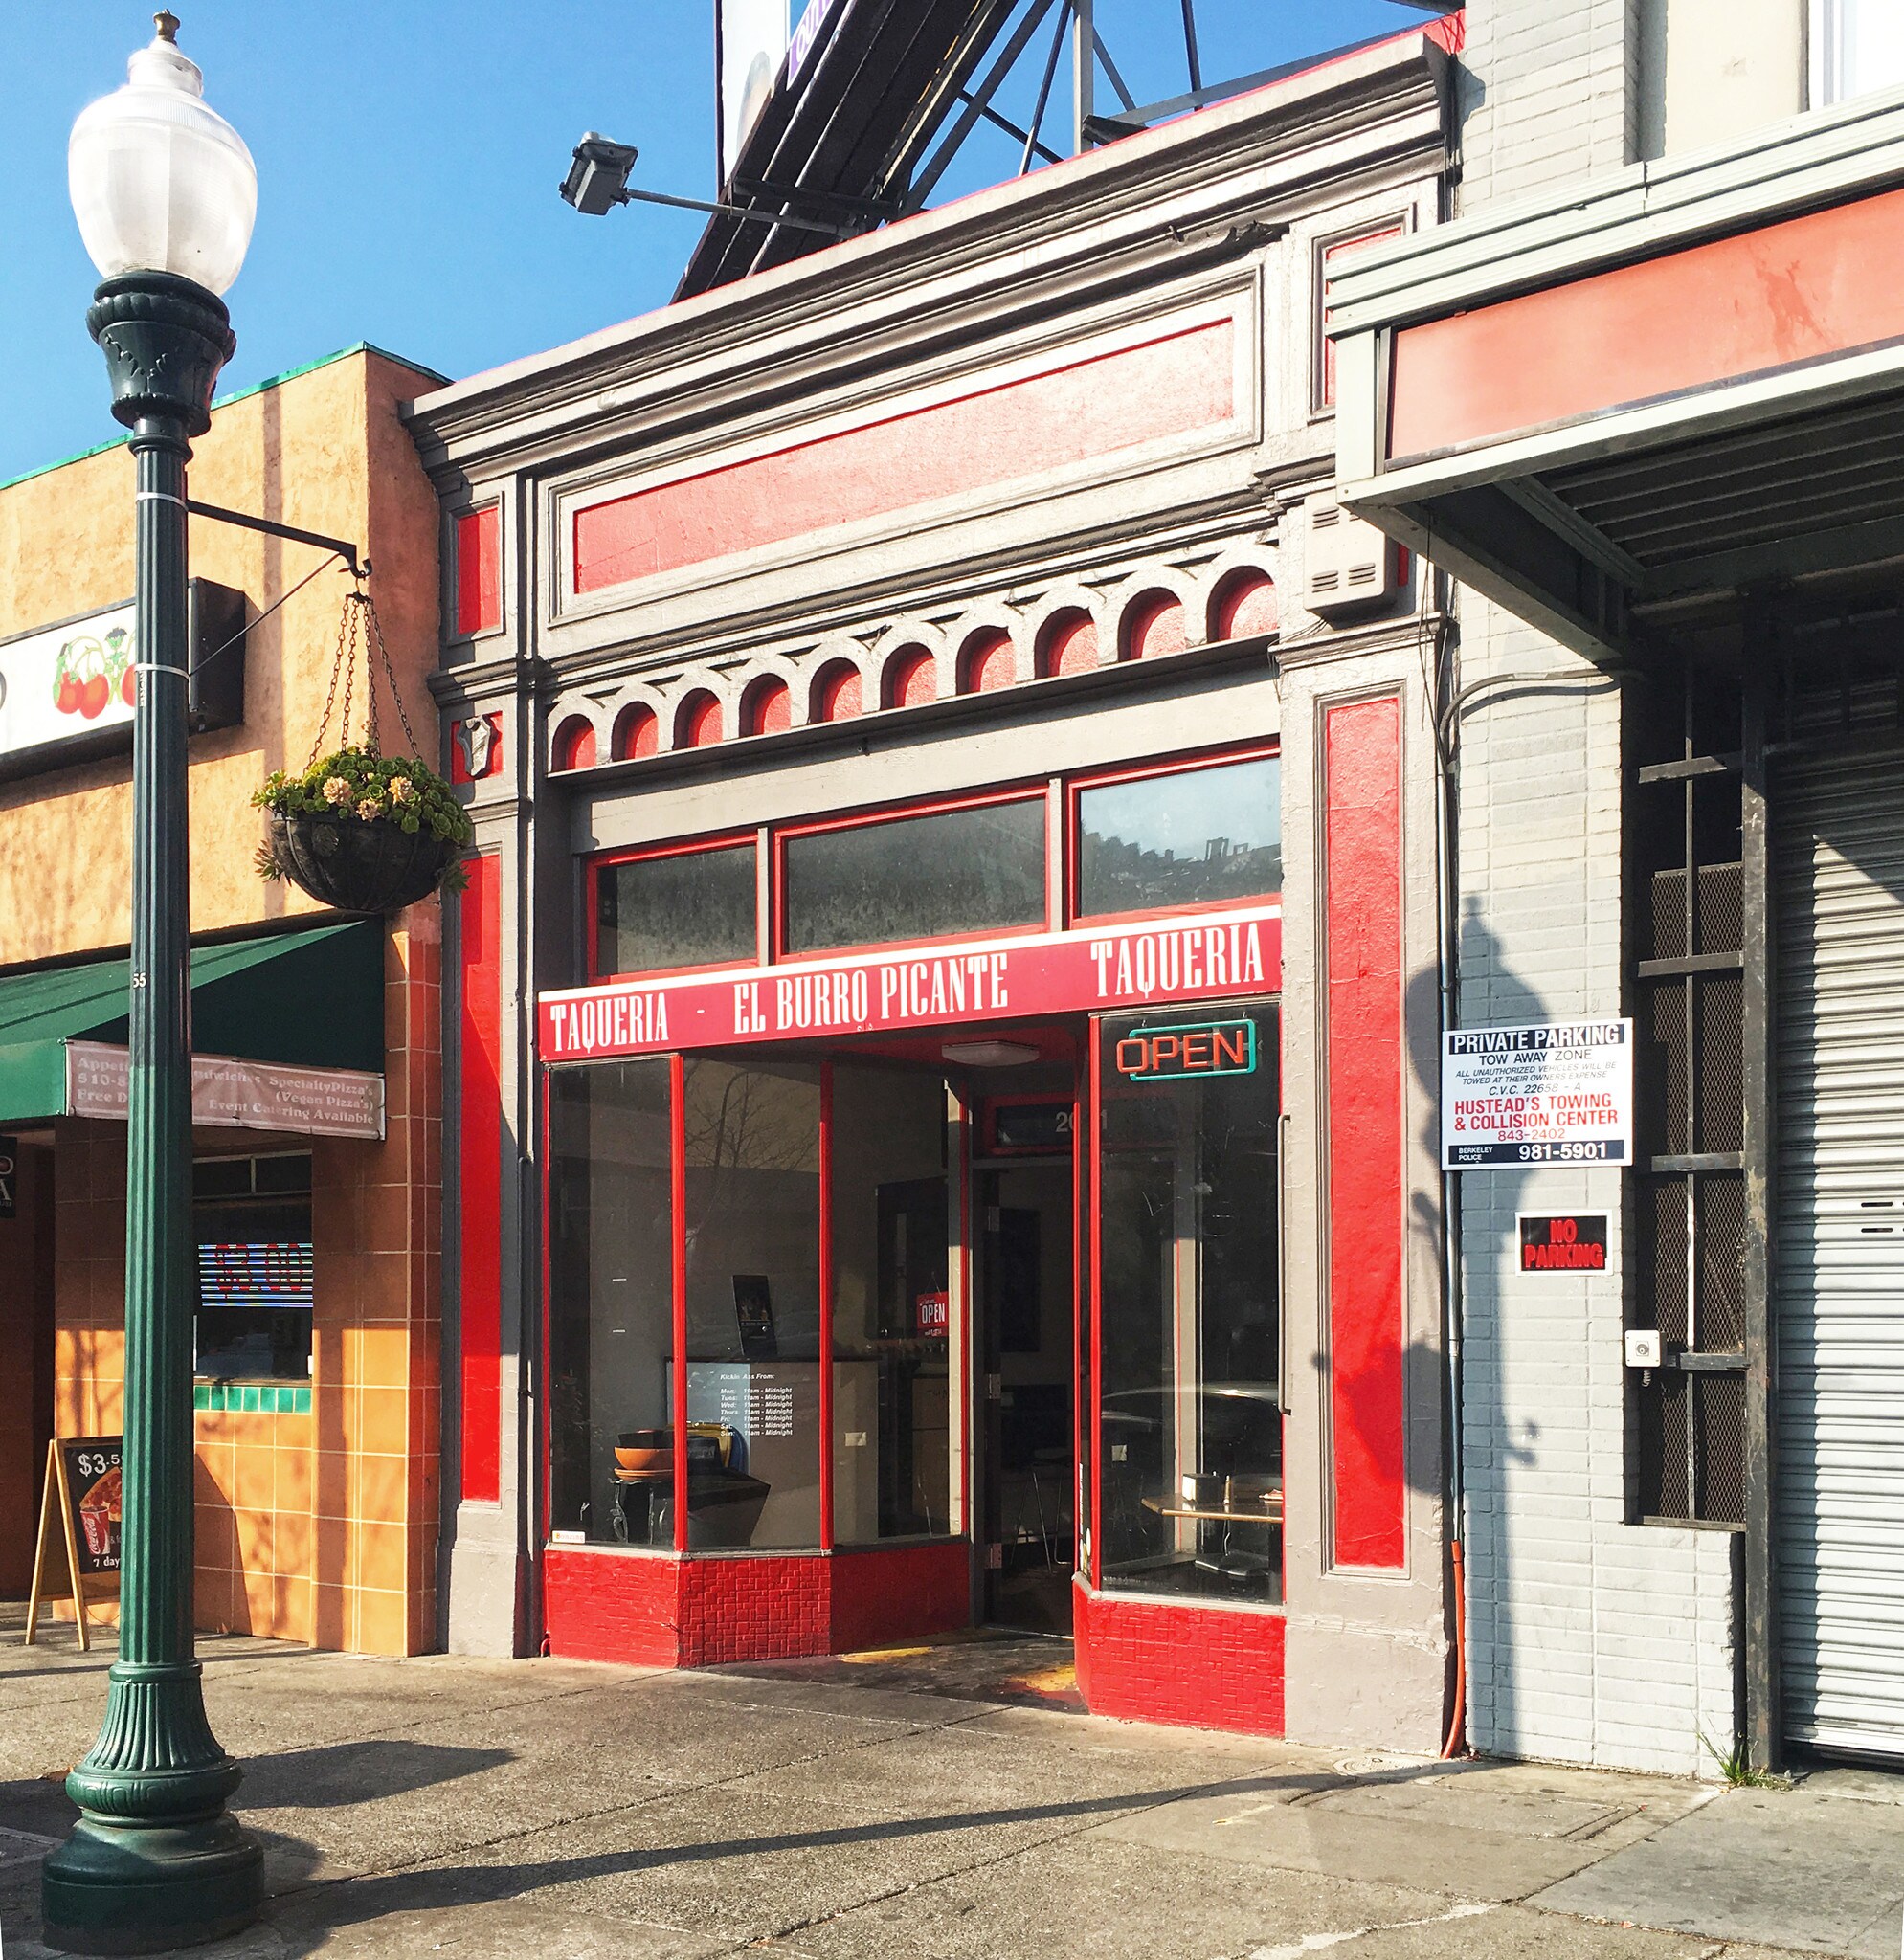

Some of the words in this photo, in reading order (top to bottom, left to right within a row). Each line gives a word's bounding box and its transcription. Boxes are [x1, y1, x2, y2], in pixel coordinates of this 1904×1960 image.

[550, 992, 669, 1054] TAQUERIA
[733, 982, 766, 1035] EL
[776, 969, 867, 1031] BURRO
[880, 952, 1008, 1020] PICANTE
[1090, 922, 1264, 999] TAQUERIA
[1454, 1031, 1529, 1054] PRIVATE
[1534, 1024, 1620, 1049] PARKING
[1116, 1030, 1244, 1074] OPEN
[1479, 1054, 1509, 1066] TOW
[1513, 1051, 1548, 1064] AWAY
[1555, 1049, 1592, 1061] ZONE
[1463, 1076, 1490, 1085] TOWED
[1505, 1075, 1528, 1083] THEIR
[1530, 1073, 1565, 1081] OWNERS
[1568, 1070, 1607, 1080] EXPENSE
[1472, 1066, 1535, 1077] UNAUTHORIZED
[1538, 1063, 1579, 1073] VEHICLES
[78, 1072, 126, 1087] 510-8
[276, 1091, 323, 1105] (Vegan
[1489, 1084, 1519, 1096] C.V.C.
[1524, 1082, 1558, 1094] 22658
[77, 1088, 112, 1102] Free
[209, 1099, 248, 1113] Event
[313, 1109, 374, 1125] Available
[1455, 1096, 1540, 1115] HUSTEAD'S
[1549, 1092, 1612, 1109] TOWING
[1454, 1117, 1466, 1131] &
[1470, 1112, 1549, 1130] COLLISION
[1557, 1109, 1618, 1126] CENTER
[1497, 1128, 1565, 1142] 843-2402
[1518, 1142, 1606, 1160] 981-5901
[1550, 1218, 1578, 1243] NO
[1524, 1243, 1604, 1268] PARKING
[921, 1303, 946, 1324] OPEN
[78, 1453, 122, 1477] $3.5
[93, 1558, 100, 1568] 7
